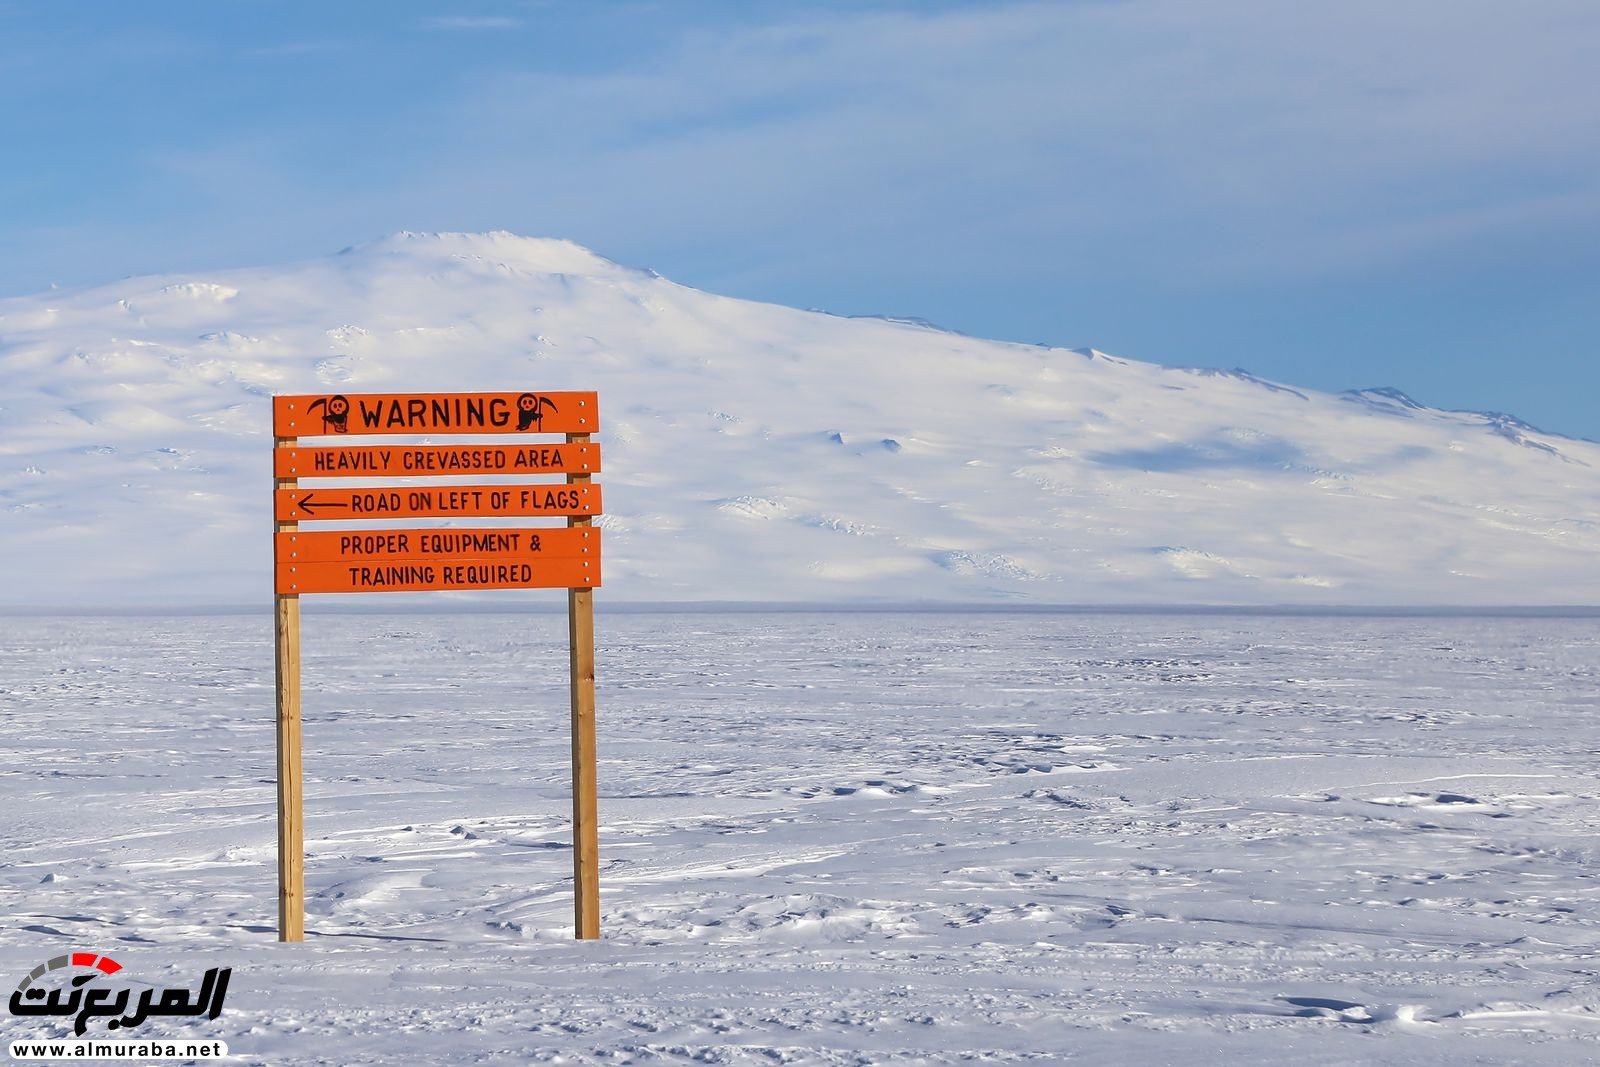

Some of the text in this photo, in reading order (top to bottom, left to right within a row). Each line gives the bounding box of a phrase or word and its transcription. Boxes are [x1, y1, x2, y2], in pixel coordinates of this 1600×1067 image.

[359, 399, 511, 428] WARNING
[315, 449, 563, 471] HEAVILY CREVASSED AREA
[351, 490, 580, 512] ROAD ON LEFT OF FLAGS
[341, 534, 542, 554] PROPER EQUIPMENT &
[349, 565, 532, 586] TRAINING REQUIRED
